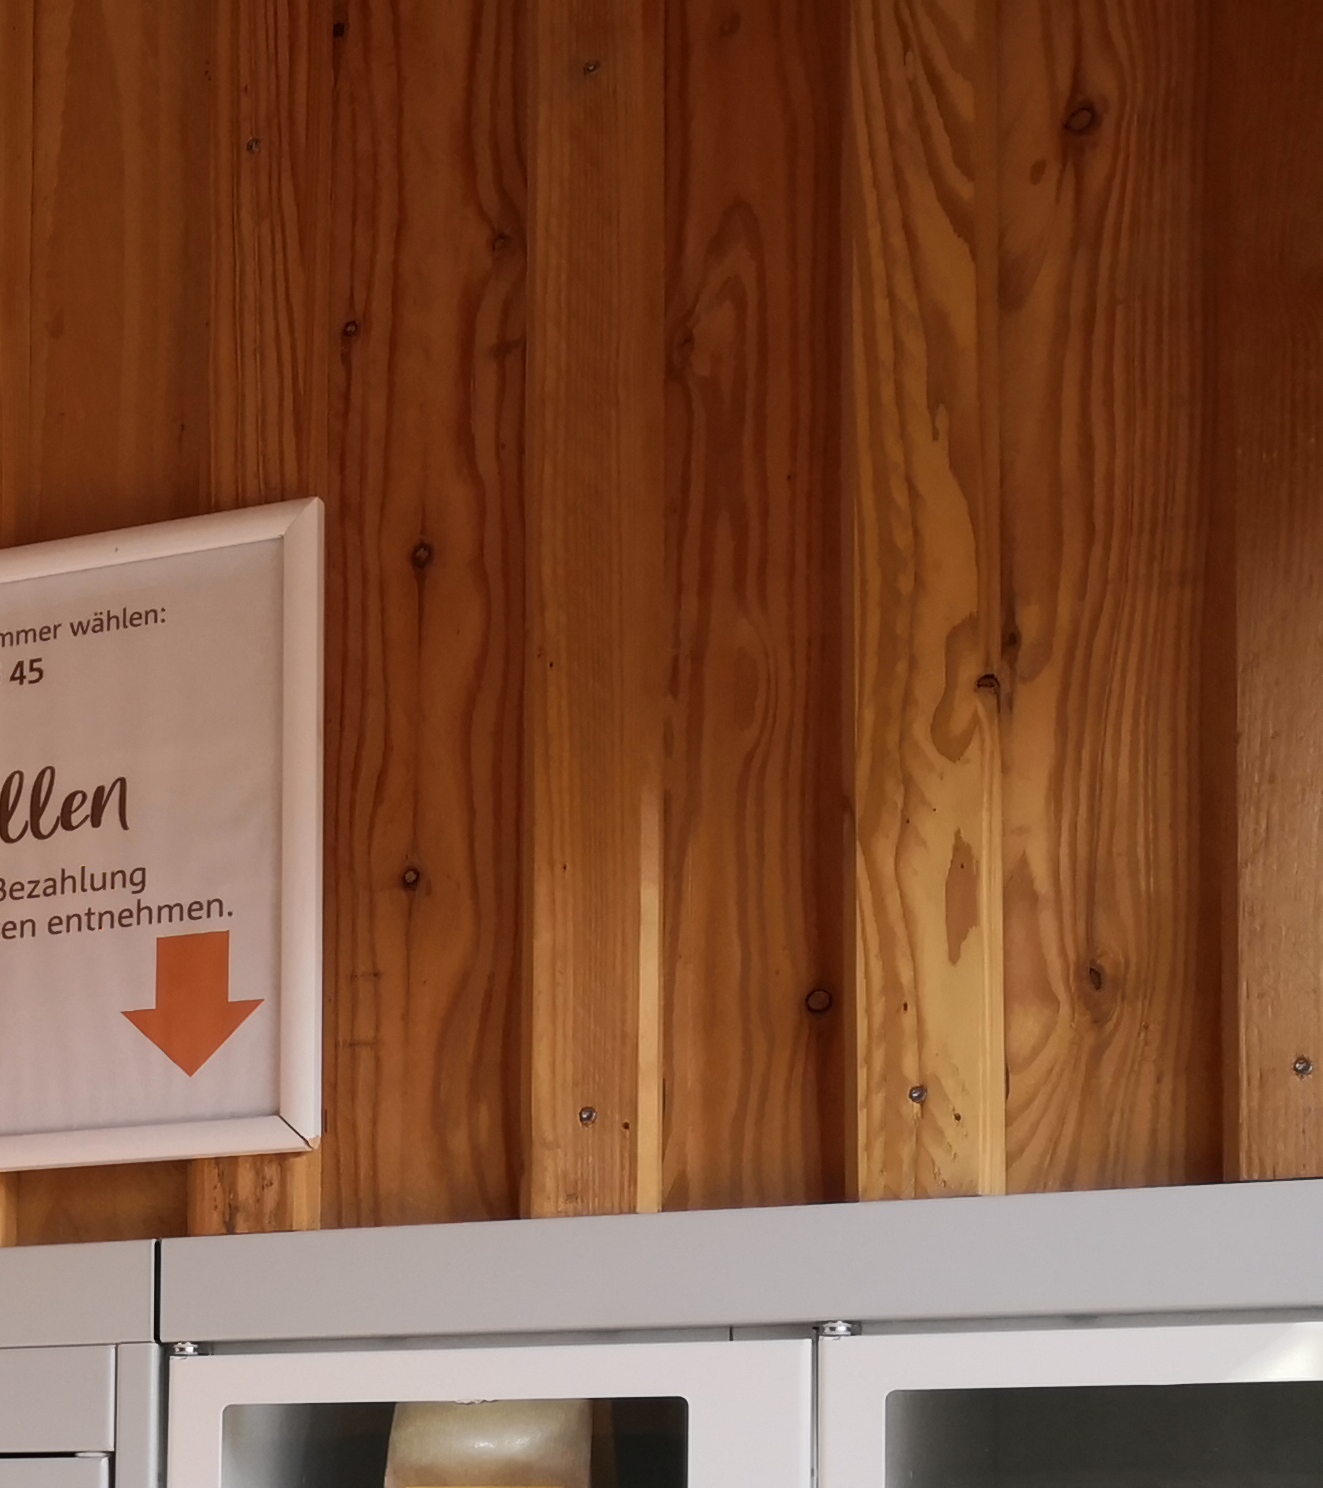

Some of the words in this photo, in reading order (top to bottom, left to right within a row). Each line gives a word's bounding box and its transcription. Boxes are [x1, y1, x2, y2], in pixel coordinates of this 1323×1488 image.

[69, 607, 166, 637] wählen:
[9, 657, 44, 685] 45
[47, 898, 234, 935] entnehmen.
